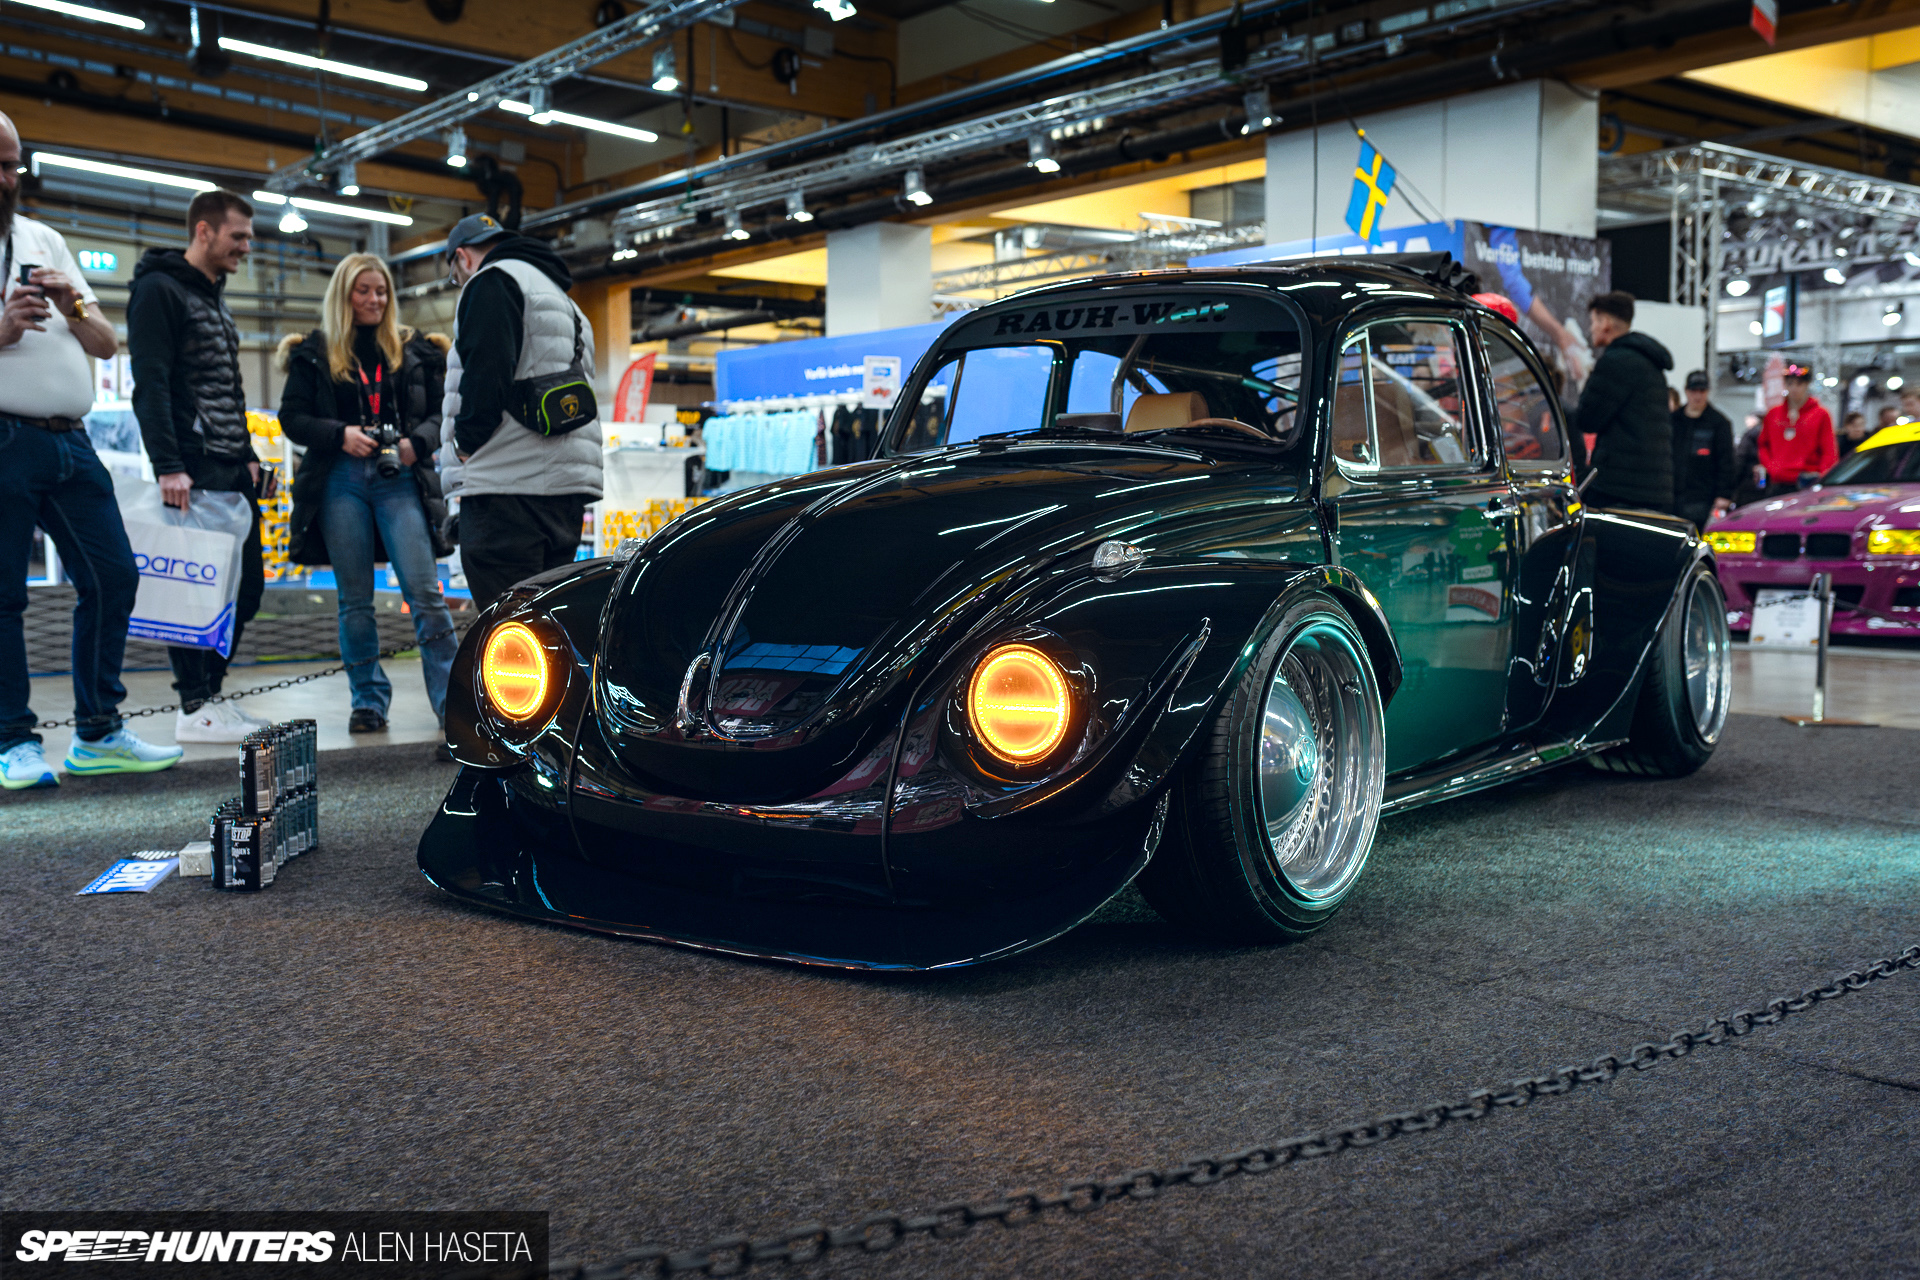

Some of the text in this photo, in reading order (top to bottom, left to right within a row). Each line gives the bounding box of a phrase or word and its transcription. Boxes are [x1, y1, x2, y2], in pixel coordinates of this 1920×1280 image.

[1474, 240, 1601, 276] Varför betala mer?
[133, 553, 217, 580] parco
[96, 862, 169, 892] BRL
